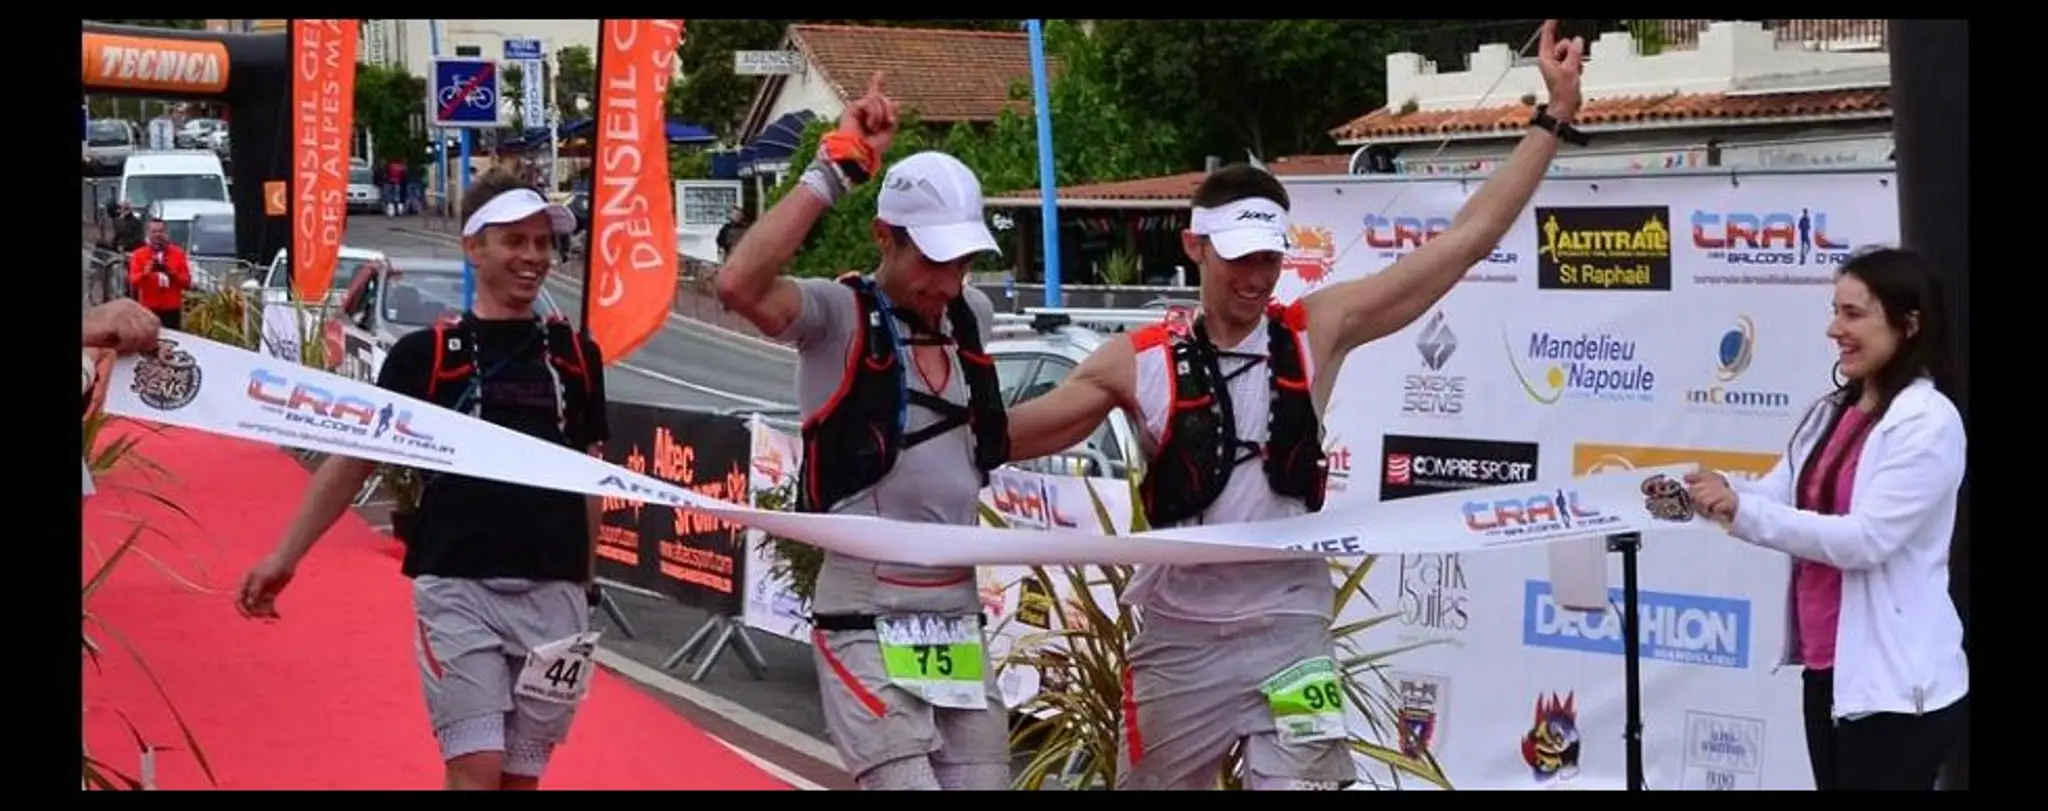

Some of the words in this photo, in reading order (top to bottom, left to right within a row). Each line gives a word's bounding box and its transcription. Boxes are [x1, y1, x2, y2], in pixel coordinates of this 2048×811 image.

[101, 44, 219, 84] TECNICA
[299, 96, 320, 268] CONSEIL
[597, 65, 642, 308] CONSEIL
[321, 192, 342, 246] DES
[626, 194, 665, 270] DES
[1558, 230, 1668, 250] ALTITRAIL
[1559, 264, 1578, 284] St
[1581, 264, 1650, 288] Raphaël
[1528, 332, 1635, 361] Mandelieu
[1567, 362, 1655, 394] Napoule
[1402, 392, 1463, 413] SENS
[544, 657, 581, 690] 44
[912, 645, 954, 676] 75
[1302, 681, 1342, 710] 96
